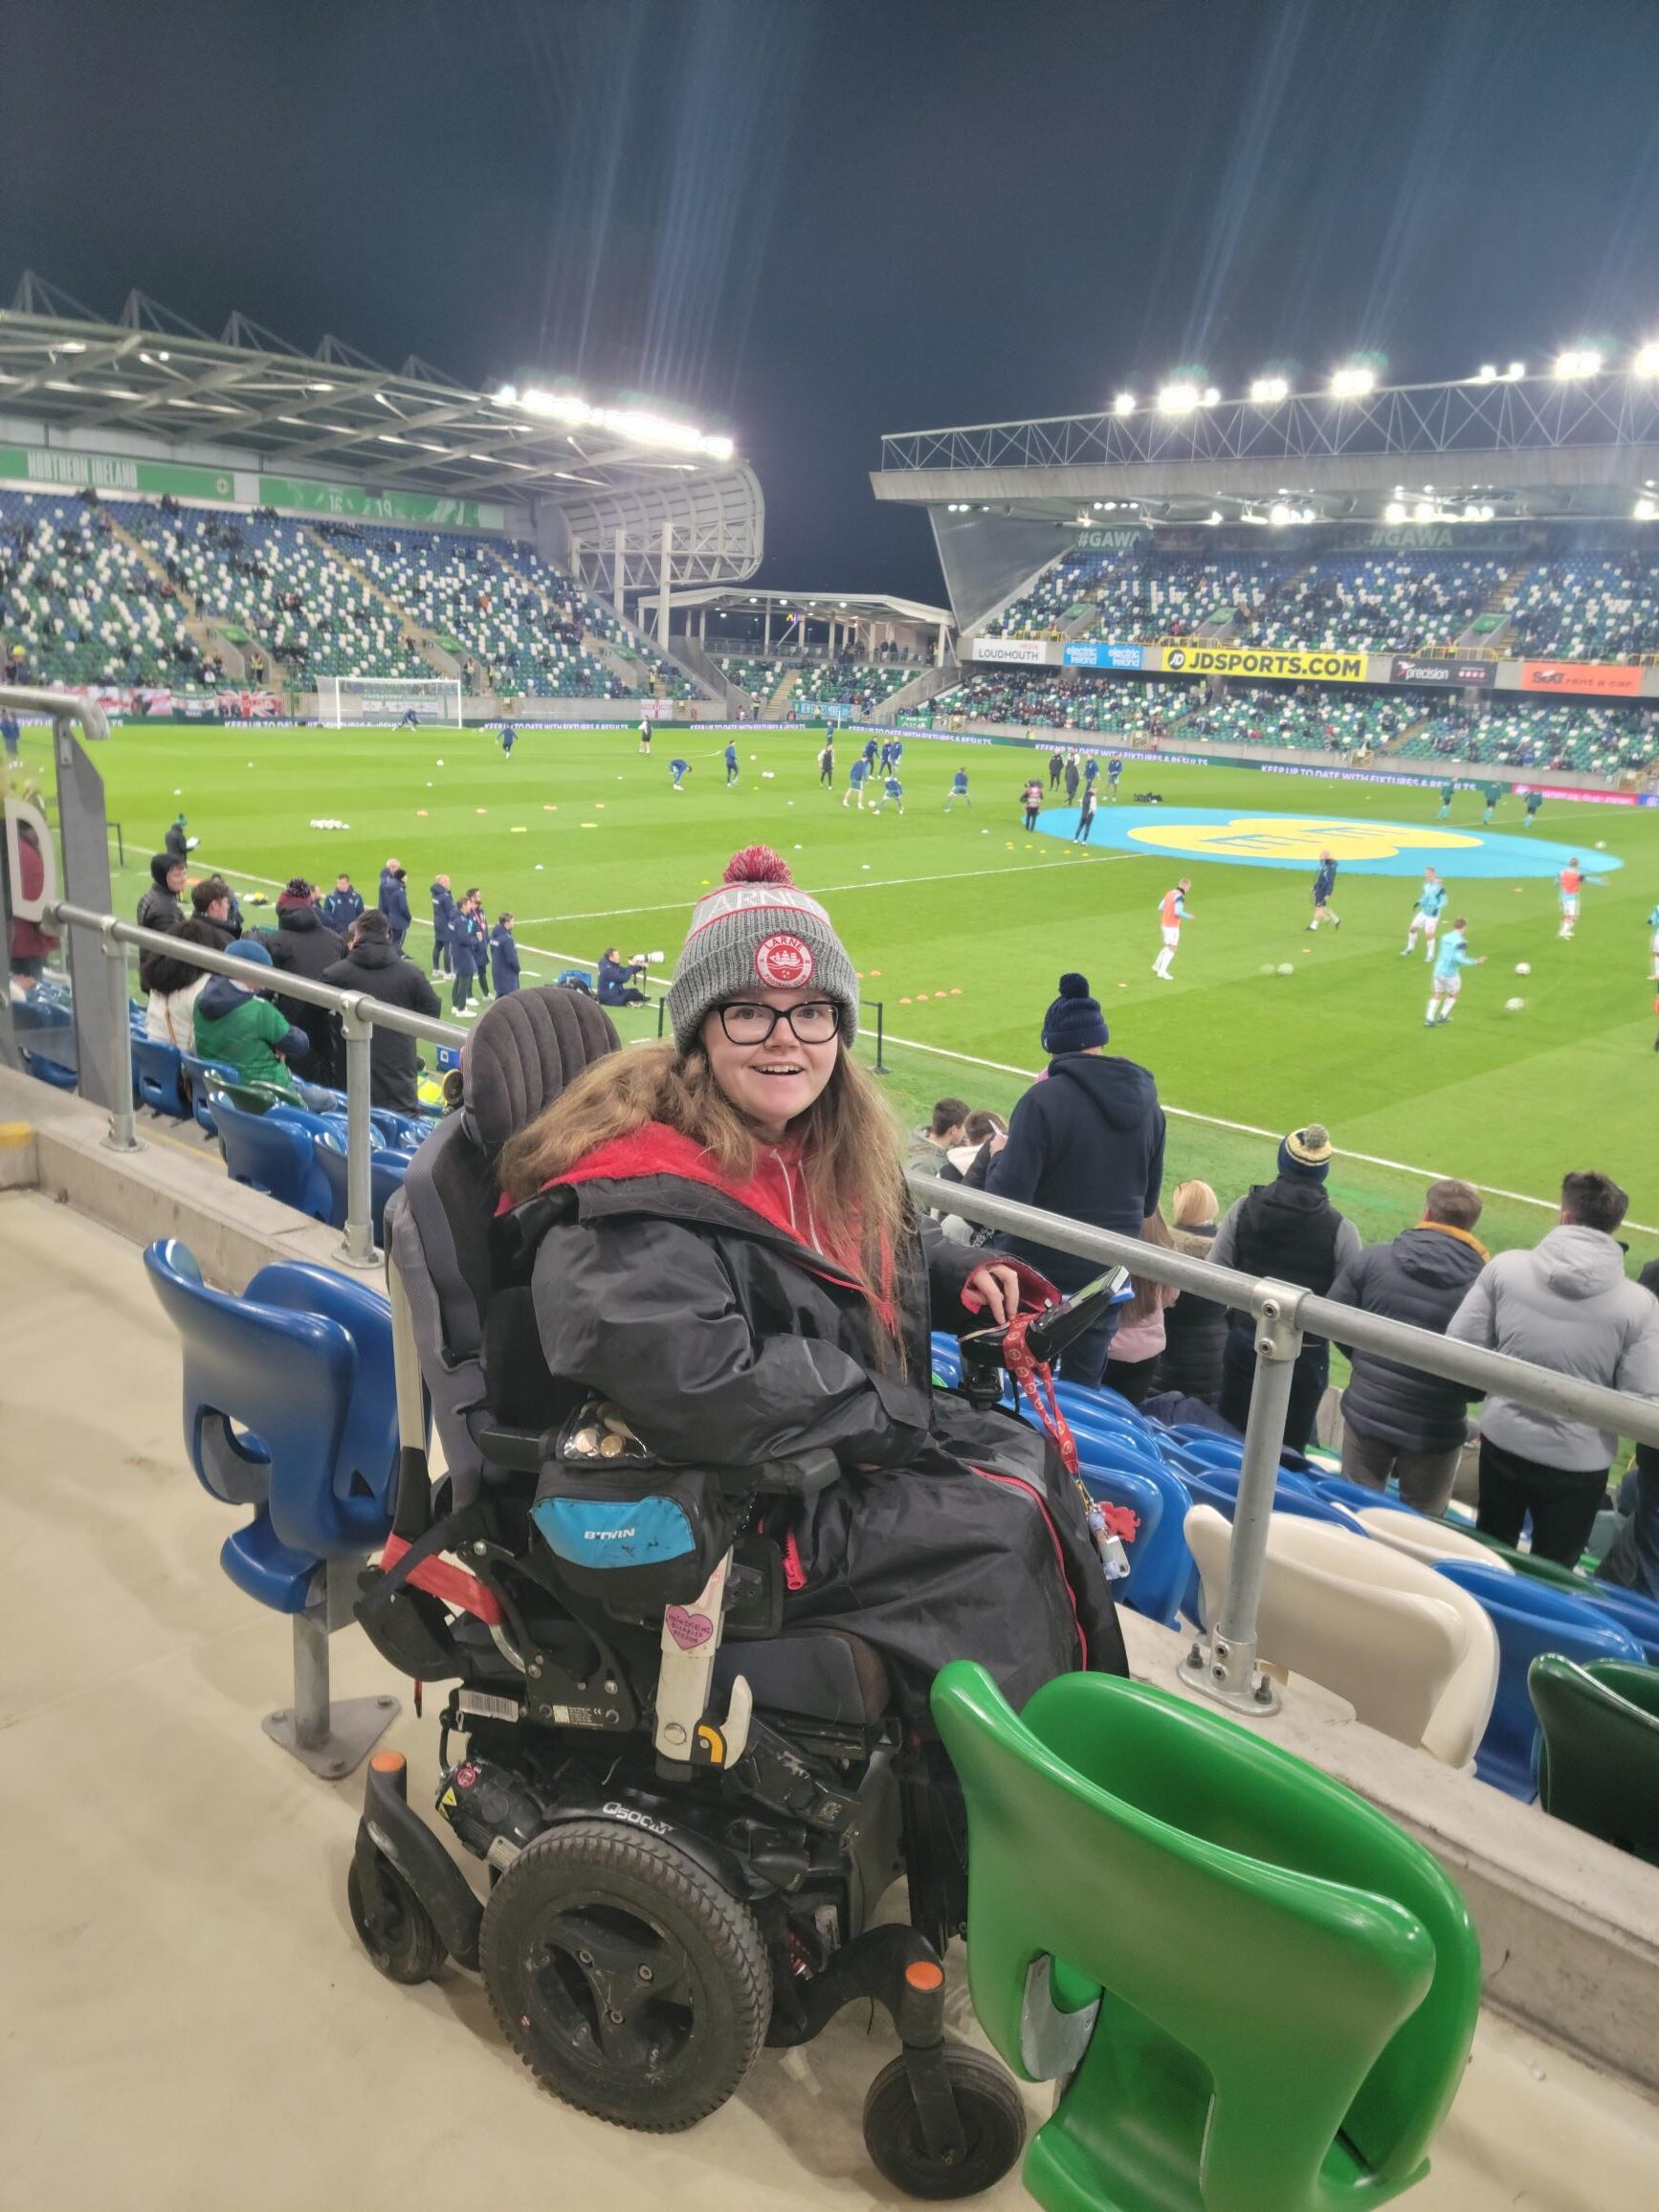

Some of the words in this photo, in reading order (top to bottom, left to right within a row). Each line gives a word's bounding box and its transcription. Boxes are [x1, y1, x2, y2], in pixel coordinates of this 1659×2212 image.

[28, 452, 88, 483] NORTHERN
[91, 458, 138, 489] IRELAND
[978, 649, 1039, 660] LOUDMOUTH
[1169, 654, 1184, 667] JD
[1189, 652, 1361, 676] JDSPORTS.COM
[1405, 668, 1449, 681] precision
[1608, 679, 1632, 688] car
[764, 936, 803, 951] LARNE
